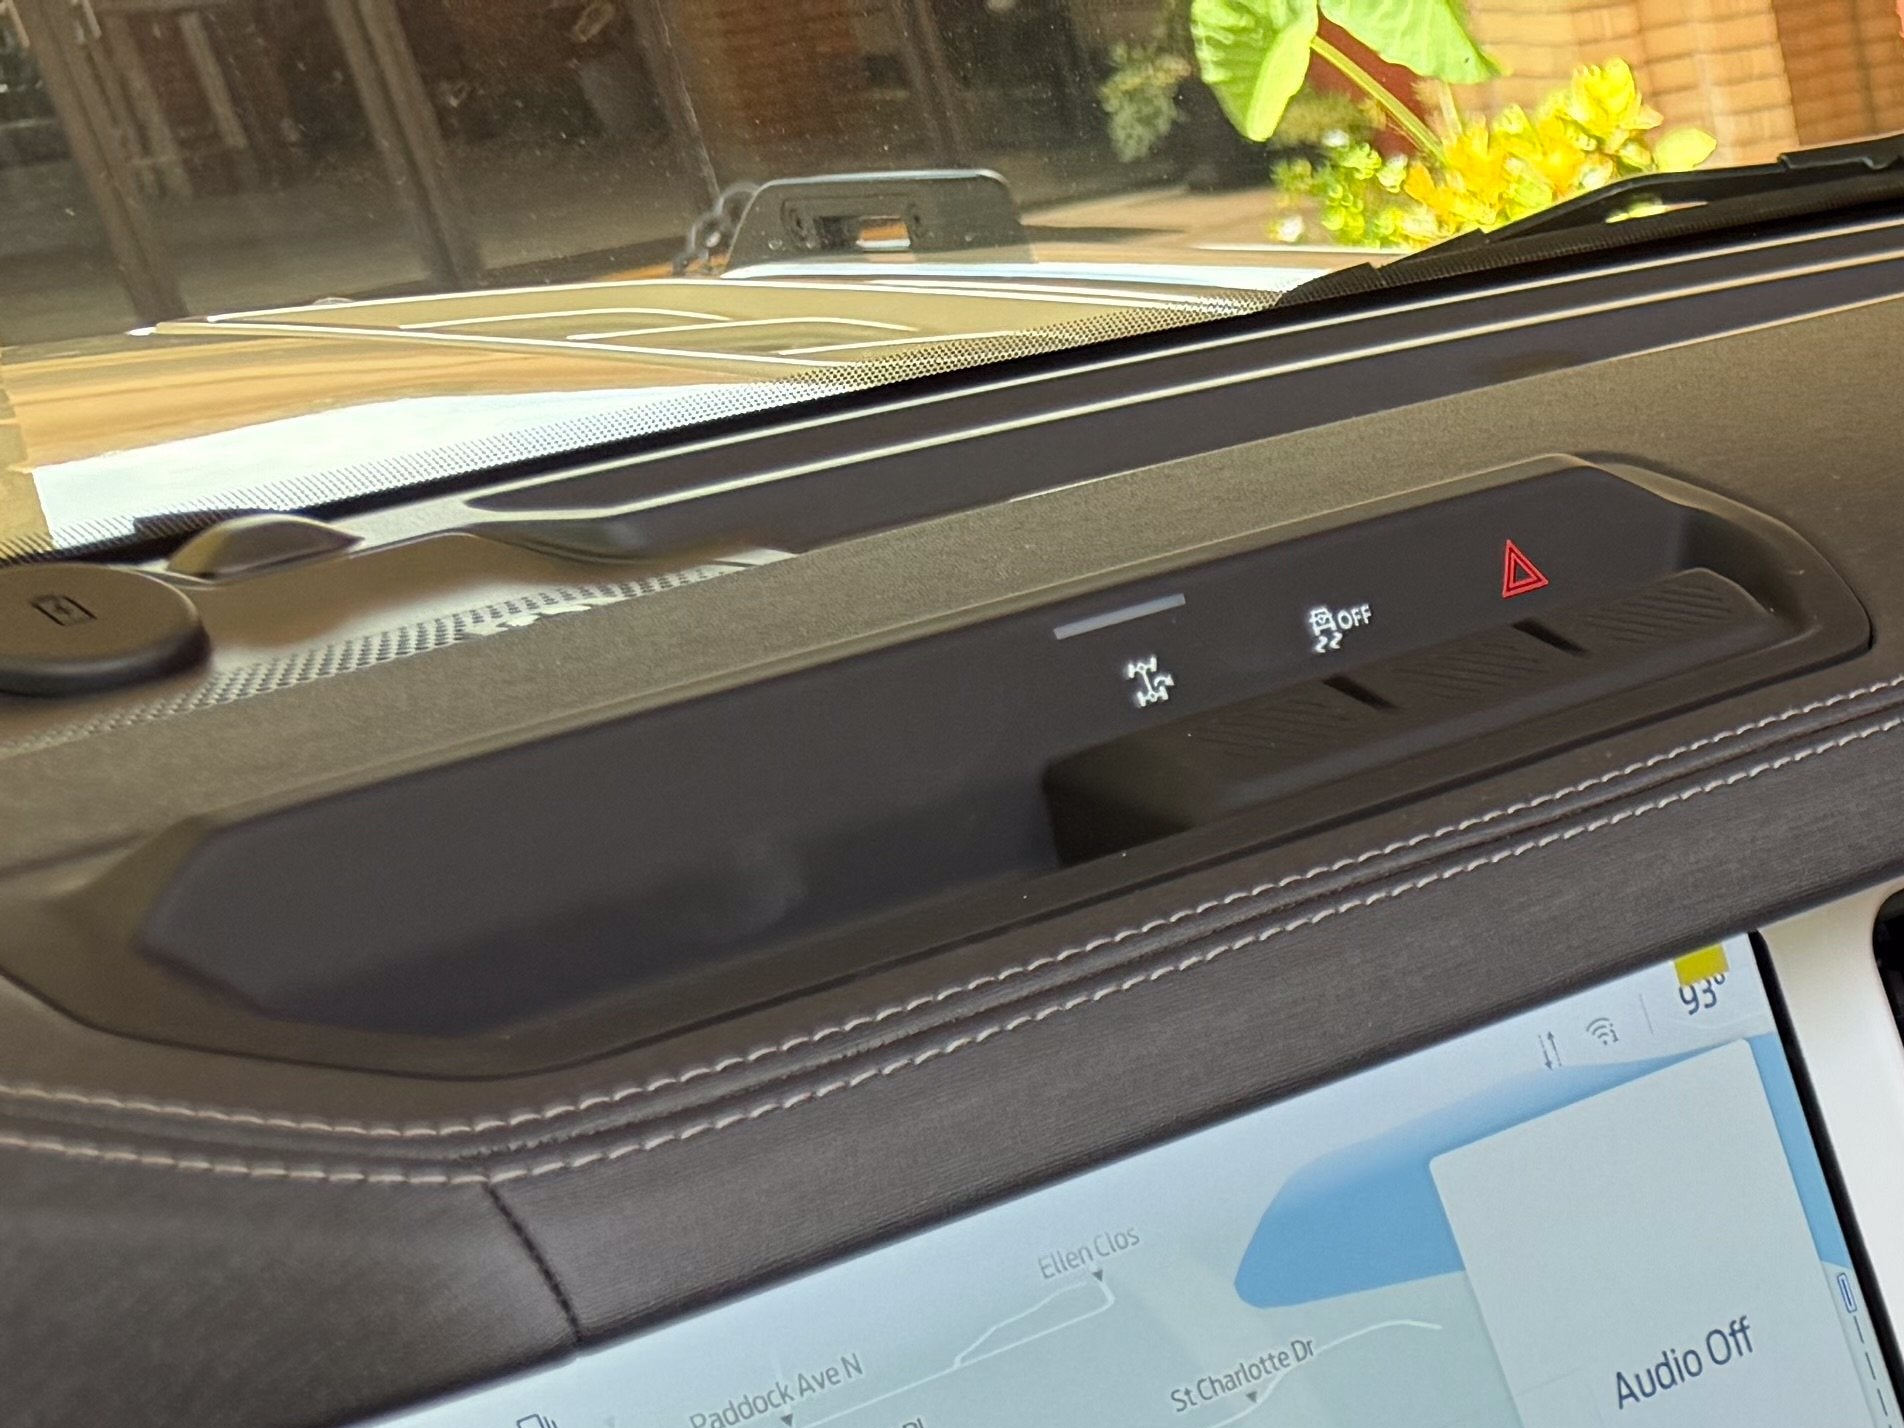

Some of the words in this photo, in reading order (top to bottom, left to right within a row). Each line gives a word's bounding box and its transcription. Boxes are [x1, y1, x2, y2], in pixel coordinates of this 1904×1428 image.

[1337, 603, 1372, 631] OFF
[1037, 1247, 1095, 1281] Ellen
[1090, 1225, 1142, 1260] Clos
[796, 1363, 837, 1402] Ave
[839, 1352, 864, 1385] N
[1170, 1386, 1197, 1413] St
[1196, 1351, 1291, 1402] Charlotte
[1290, 1338, 1316, 1366] Dr
[1614, 1340, 1704, 1410] Audio
[1703, 1315, 1755, 1369] Off
